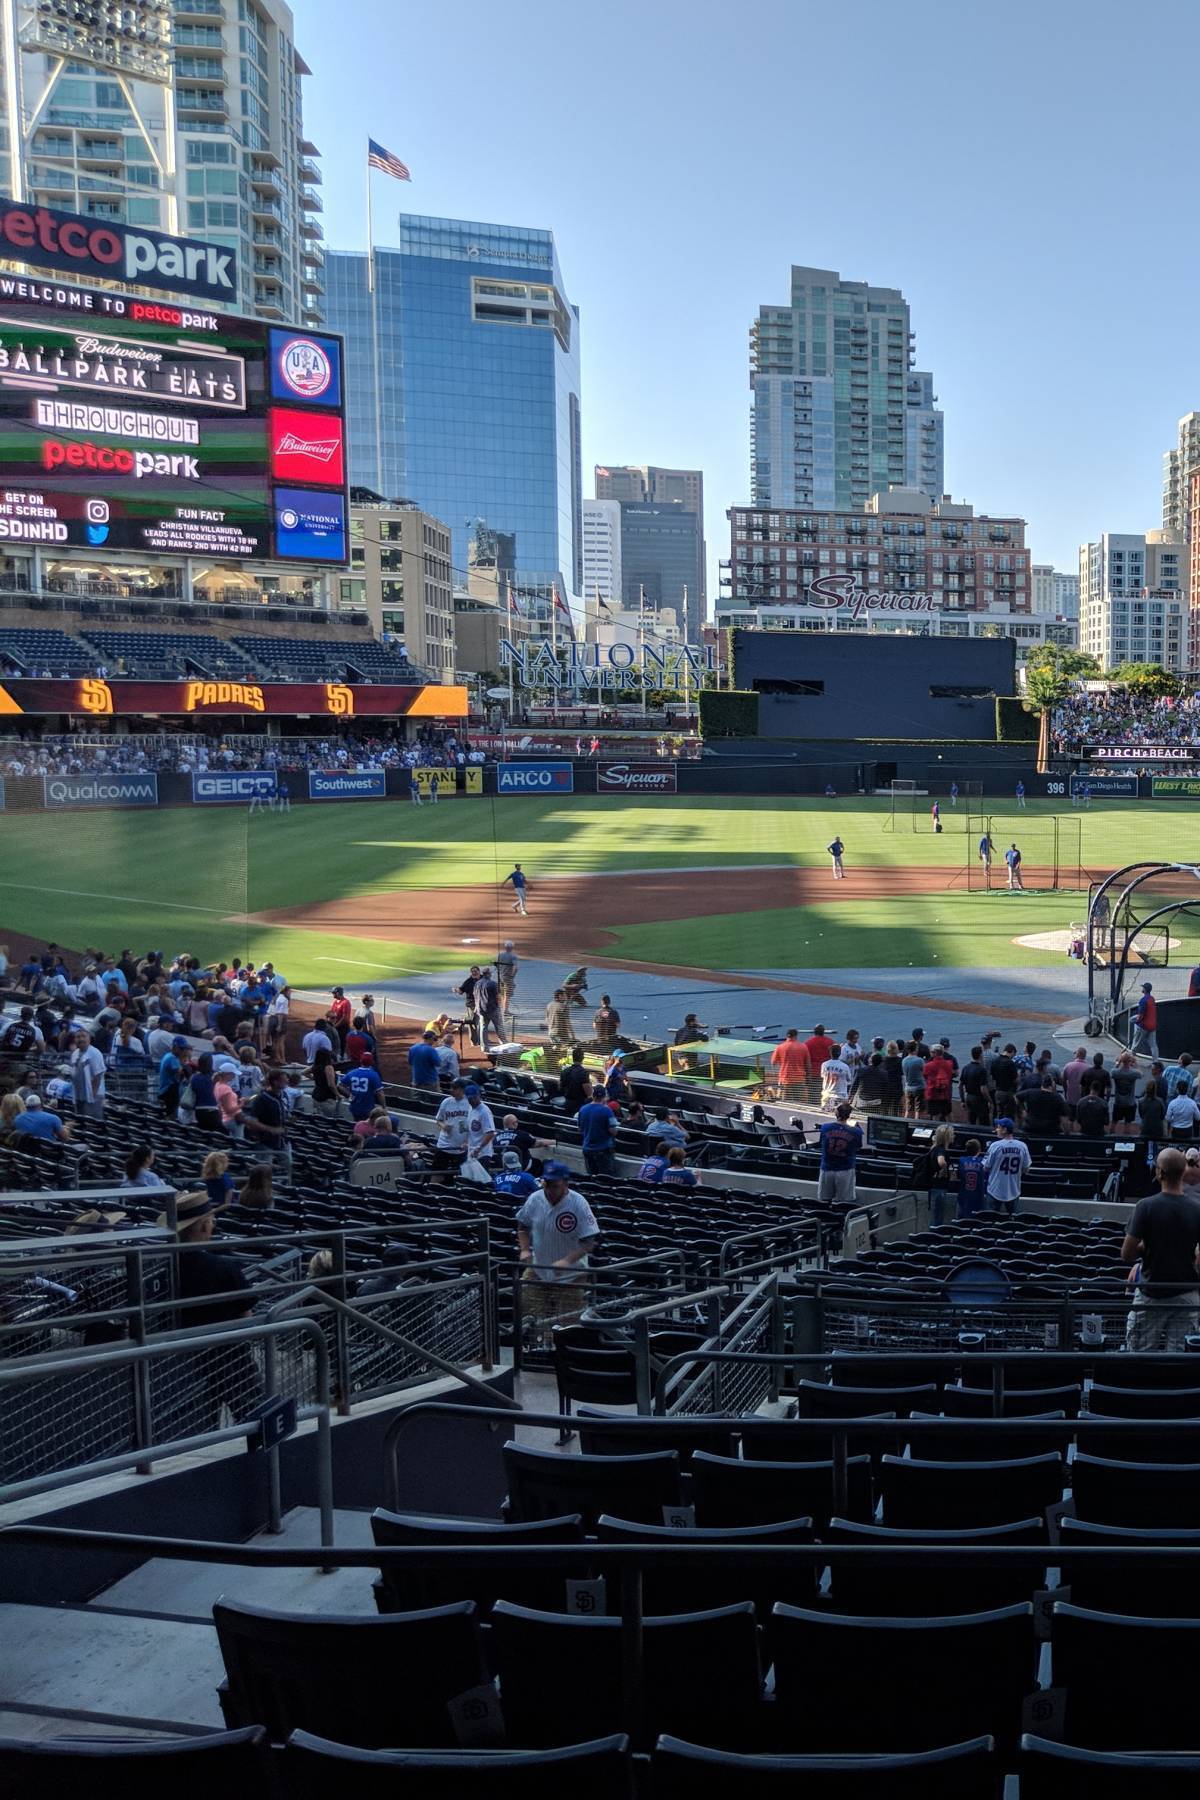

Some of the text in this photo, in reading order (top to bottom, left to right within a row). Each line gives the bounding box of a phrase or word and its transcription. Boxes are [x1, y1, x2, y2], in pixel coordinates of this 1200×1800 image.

[0, 208, 234, 289] etcopark
[1, 279, 93, 308] WELCOME
[103, 298, 125, 314] TO
[75, 336, 163, 362] Budweiser
[0, 348, 237, 401] BALLPARK EATS
[40, 402, 198, 441] THROUGHOUT
[281, 436, 332, 454] Budweiser
[5, 492, 44, 505] GET ON
[0, 504, 57, 518] HE SCREEN
[178, 508, 225, 522] FUN FACT
[145, 529, 169, 539] LEADS
[170, 531, 184, 540] ALL
[185, 532, 217, 542] ROOKIES
[218, 534, 236, 544] WITH
[160, 522, 243, 536] CHRISTIAN VILLANUEVA
[151, 539, 167, 547] AND
[168, 540, 193, 549] RANKS
[194, 541, 209, 550] 2ND
[210, 543, 229, 552] WITH
[807, 573, 940, 621] Sycuan
[499, 638, 724, 673] NATIONAL
[517, 666, 707, 690] UNIVERSITY
[187, 682, 267, 712] PADRES
[1098, 748, 1140, 757] PIRCH
[1151, 749, 1188, 758] BEACH
[315, 777, 374, 790] Southwest
[417, 771, 476, 784] STANLY
[501, 770, 552, 786] ARCO
[600, 765, 669, 788] Sycuan
[1154, 781, 1181, 790] WEST
[50, 781, 153, 802] Qualcomm
[198, 777, 274, 795] GEICO
[1047, 782, 1065, 794] 396
[1097, 783, 1114, 791] Diego
[350, 1076, 369, 1092] 23
[1000, 1157, 1021, 1175] 49
[369, 1172, 391, 1187] 104
[965, 1172, 977, 1191] 9
[276, 1414, 284, 1434] E
